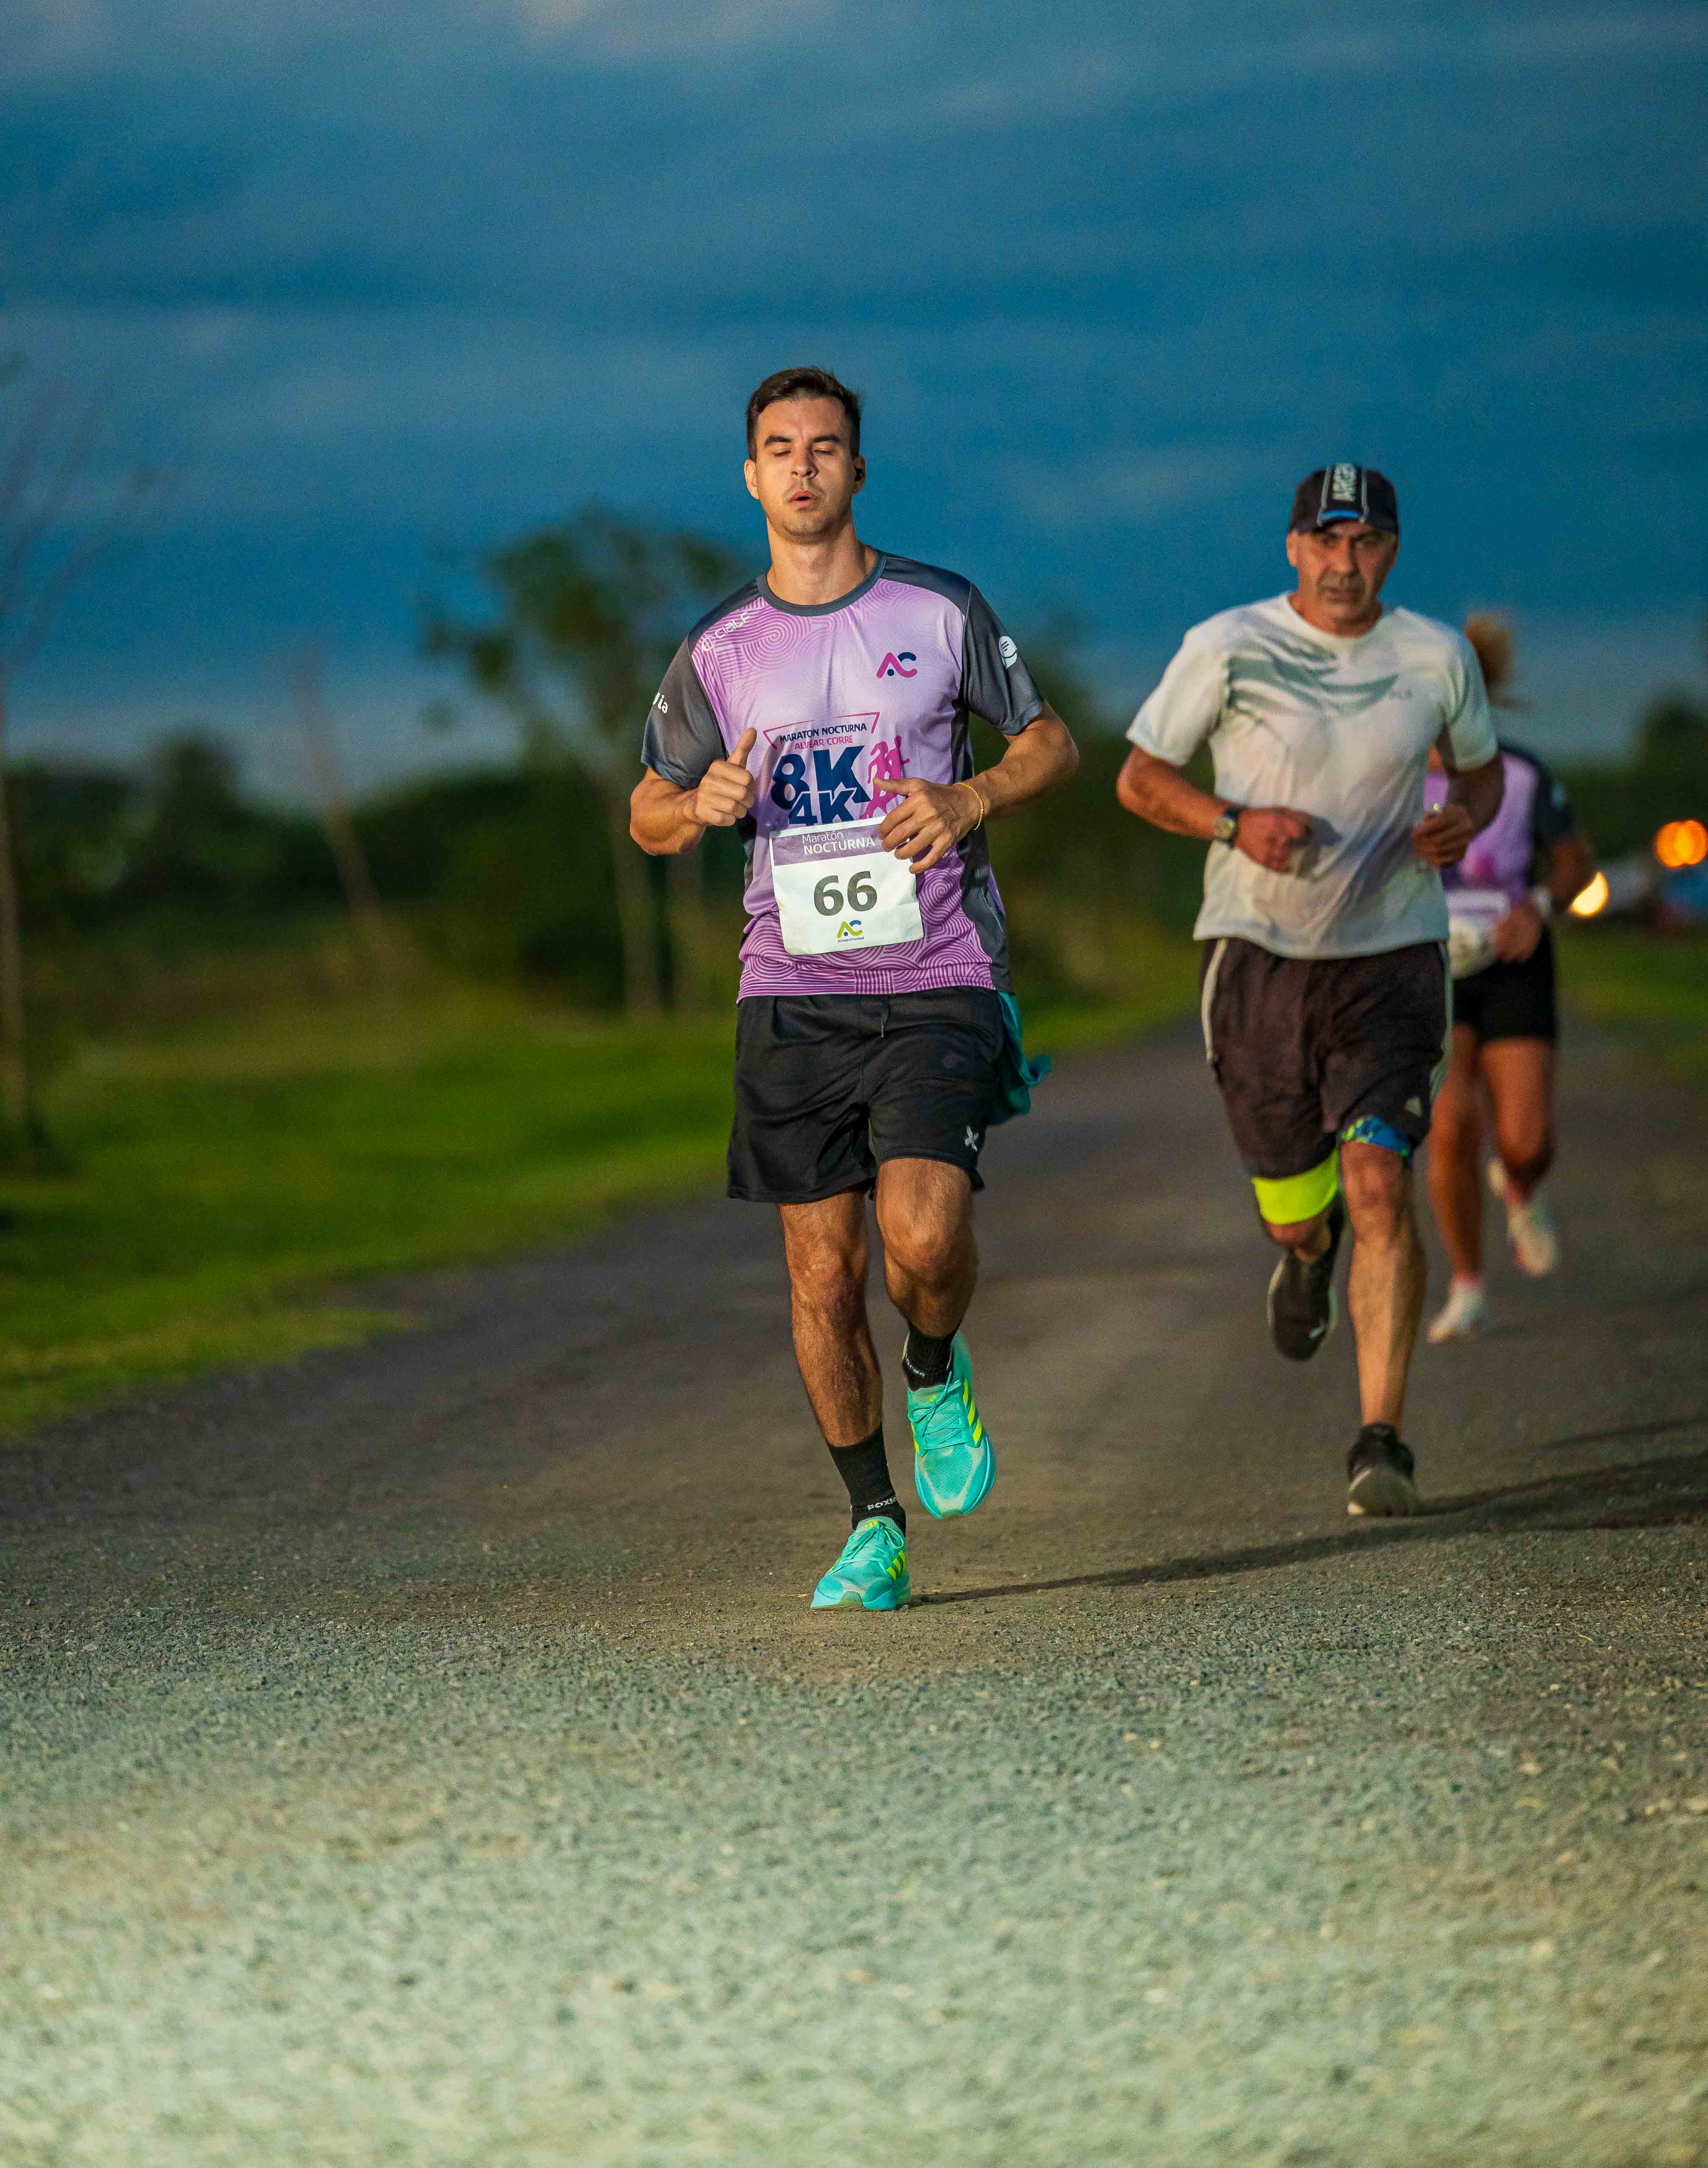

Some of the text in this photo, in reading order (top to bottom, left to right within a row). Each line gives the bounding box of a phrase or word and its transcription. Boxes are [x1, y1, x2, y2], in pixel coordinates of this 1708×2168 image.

[779, 722, 868, 743] MARATON NOCTURNA
[794, 735, 854, 750] ALVEAR CORRE
[770, 745, 873, 811] 8K
[787, 790, 854, 826] 4K
[802, 830, 844, 844] Maratón
[803, 837, 875, 855] NOCTURNA
[813, 871, 878, 916] 66
